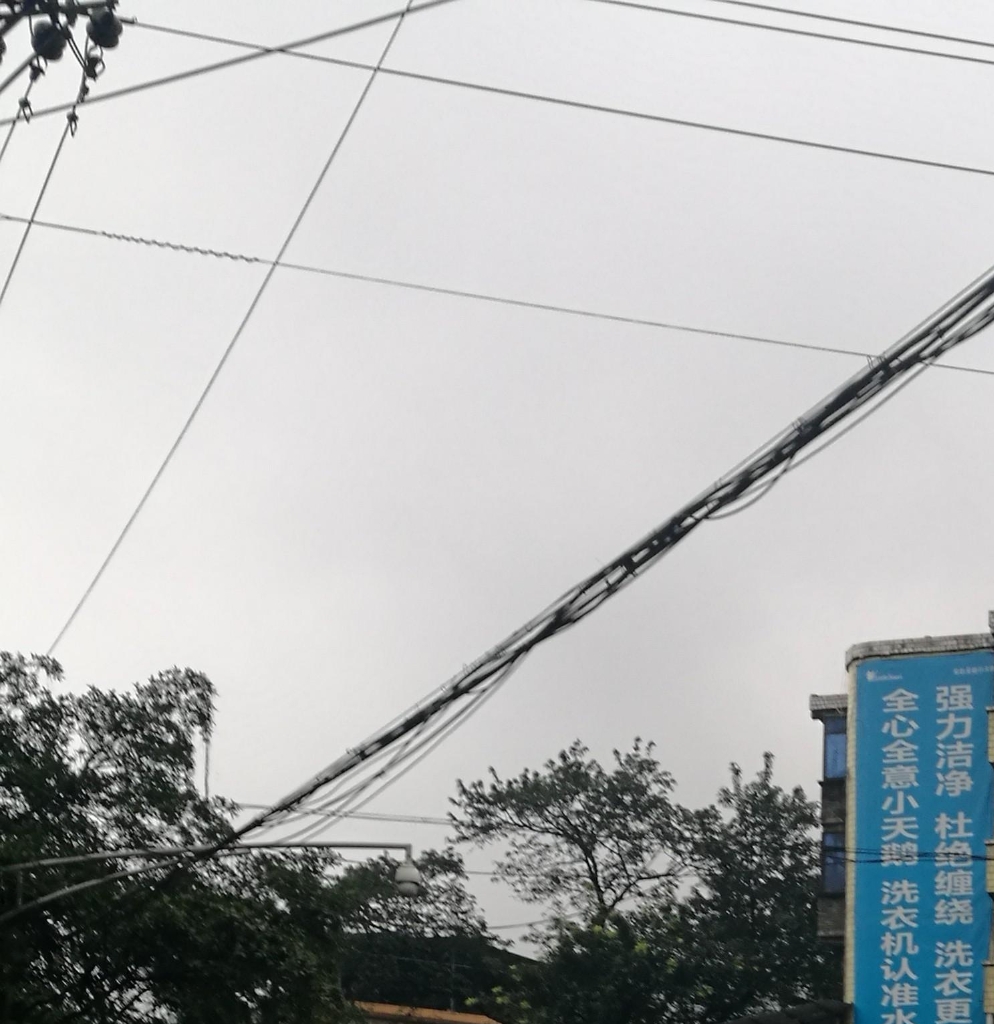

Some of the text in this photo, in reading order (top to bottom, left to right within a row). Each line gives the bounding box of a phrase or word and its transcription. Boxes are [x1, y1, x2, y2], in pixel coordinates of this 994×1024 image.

[881, 687, 920, 868] 全心全意小天鹅
[935, 684, 974, 797] 强力洁净
[933, 811, 974, 926] 杜绝缠绕
